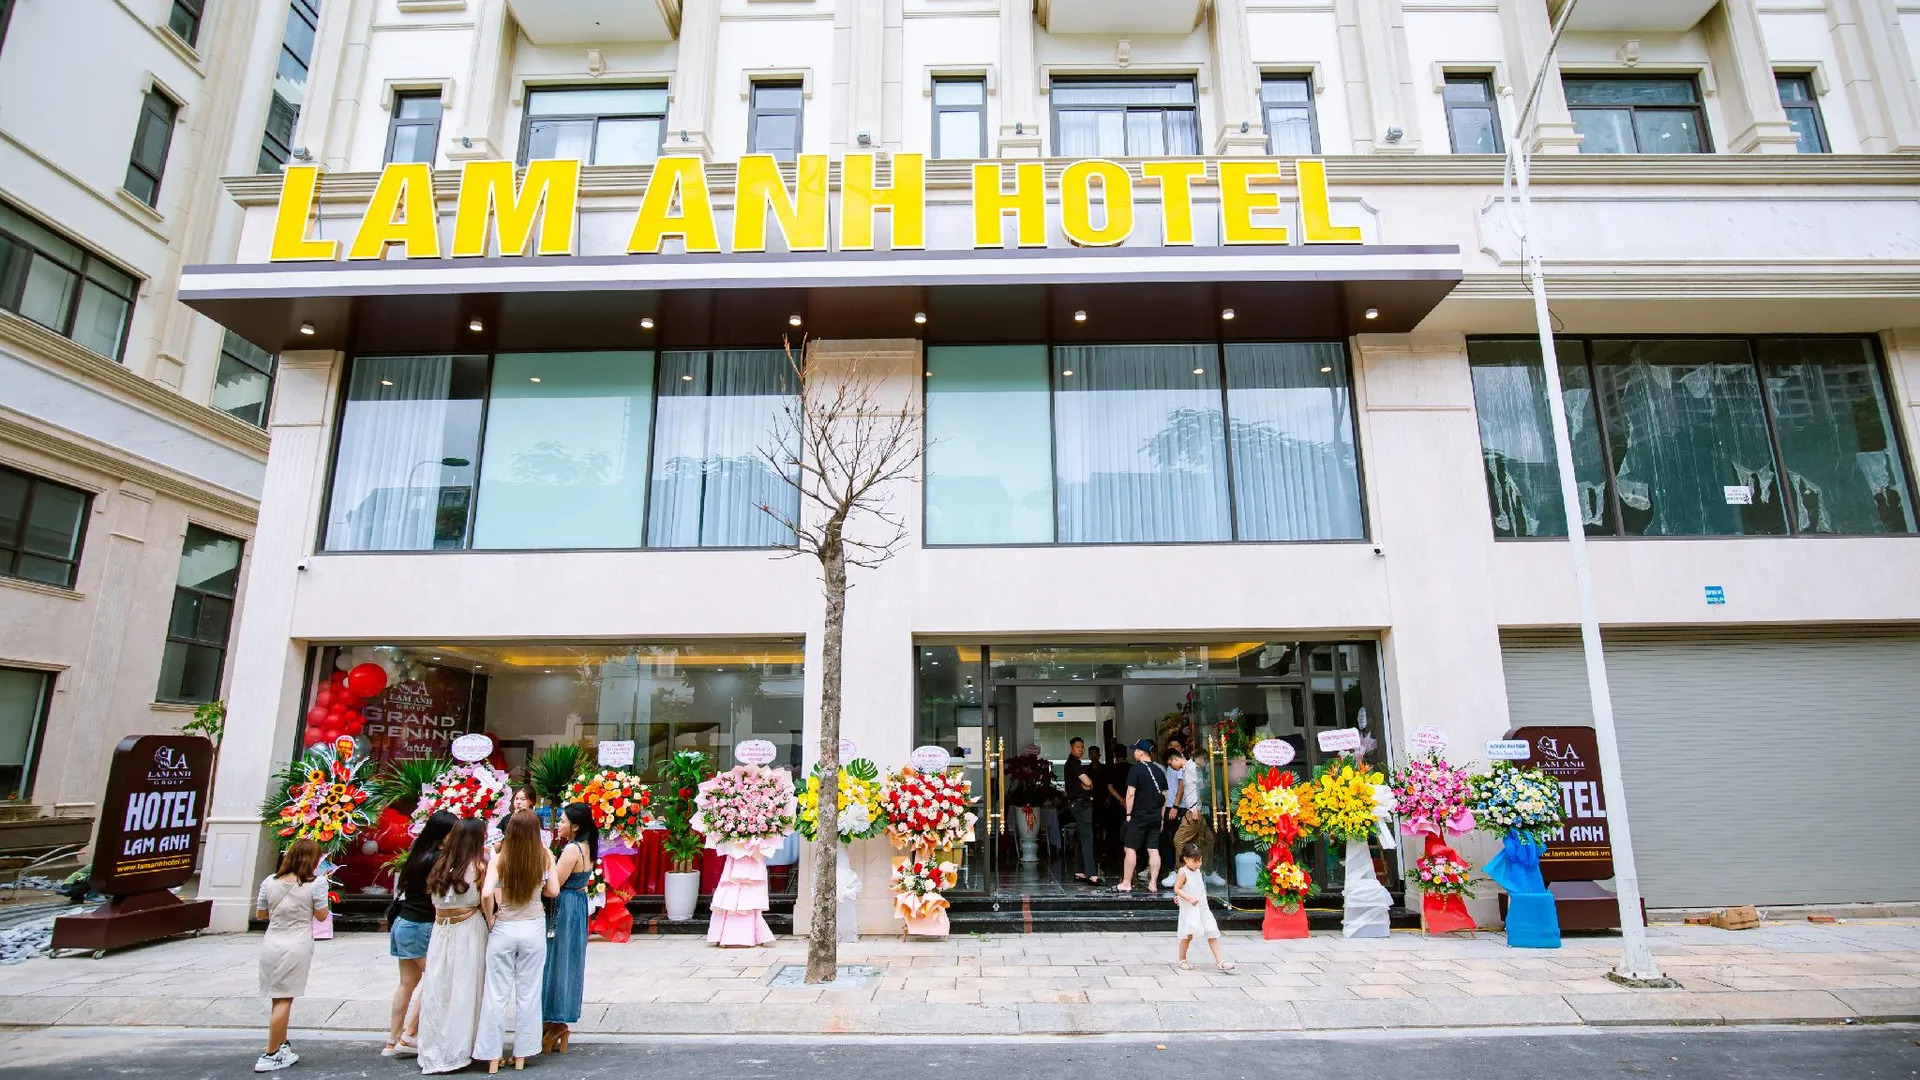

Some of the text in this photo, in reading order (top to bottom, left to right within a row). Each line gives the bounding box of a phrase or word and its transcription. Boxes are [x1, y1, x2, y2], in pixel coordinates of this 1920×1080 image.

[270, 152, 1363, 262] LAM ANH HOTEL
[362, 706, 456, 727] GRAND
[361, 724, 464, 740] PENING
[123, 790, 197, 832] HOTEL
[1541, 825, 1604, 843] AM ANH
[123, 833, 191, 857] LAM ANH
[117, 858, 191, 873] www.lamanhhotel.vn
